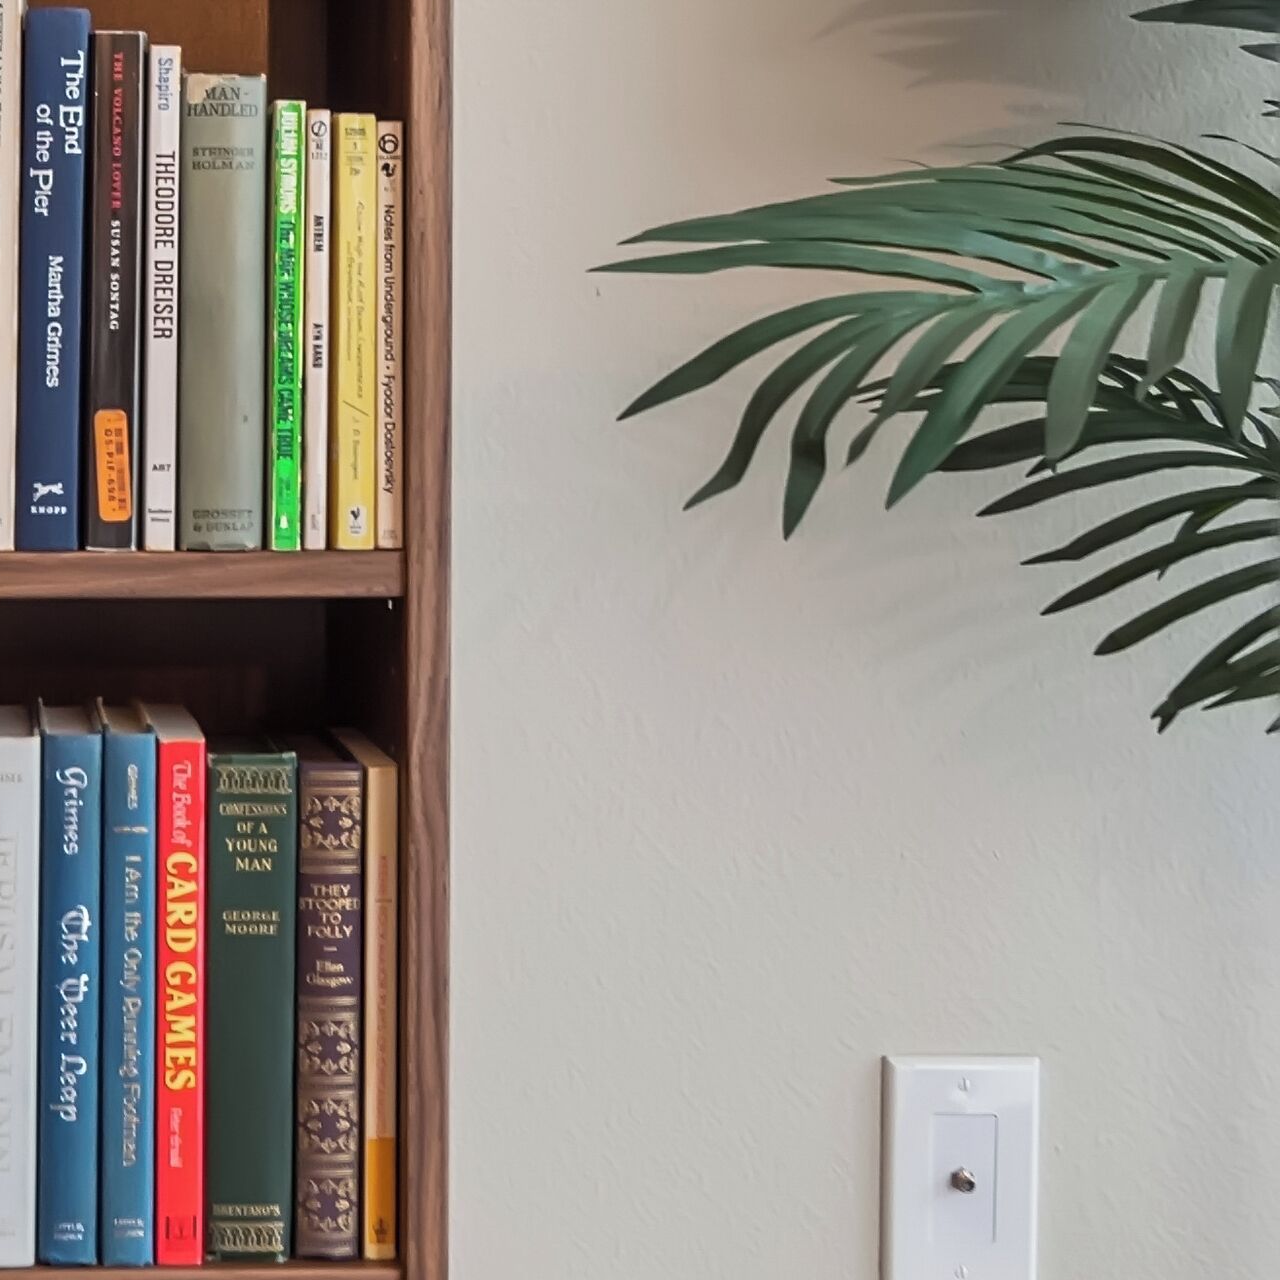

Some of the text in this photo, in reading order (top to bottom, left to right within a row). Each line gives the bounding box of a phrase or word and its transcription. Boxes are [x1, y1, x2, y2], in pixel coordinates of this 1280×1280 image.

[59, 50, 85, 155] The End
[154, 57, 174, 112] Shapiro
[186, 102, 259, 118] HANDLED
[110, 52, 124, 209] THE VOLCANO LOVER
[29, 104, 55, 217] of the Pier
[191, 160, 256, 171] HOLMAN
[152, 150, 176, 340] THEODORE DREISER
[313, 214, 325, 253] ANTHEM
[108, 219, 122, 331] SUSAN SONTAG
[381, 204, 396, 361] Notes from Underground
[45, 254, 65, 389] Martha Grimes
[312, 322, 324, 369] AYN RAND
[381, 374, 396, 495] Fyodor Dostoevsky
[30, 505, 68, 515] KNOPF
[55, 766, 88, 856] Grimes
[219, 803, 288, 816] CONFESSIONS
[236, 821, 268, 834] OF A
[225, 837, 278, 853] YOUNG
[235, 857, 273, 872] MAN
[124, 867, 142, 904] Am
[299, 897, 361, 911] STOOPED
[310, 883, 352, 897] THEY
[124, 910, 143, 942] the
[163, 761, 198, 1092] The Book of CARD GAMES
[222, 909, 281, 922] GEORGE
[224, 923, 280, 936] MOORE
[307, 924, 354, 939] FOLLY
[319, 911, 342, 925] TO
[119, 947, 143, 992] Only
[305, 972, 355, 988] Glasgow
[49, 904, 93, 1123] The Deer Leap
